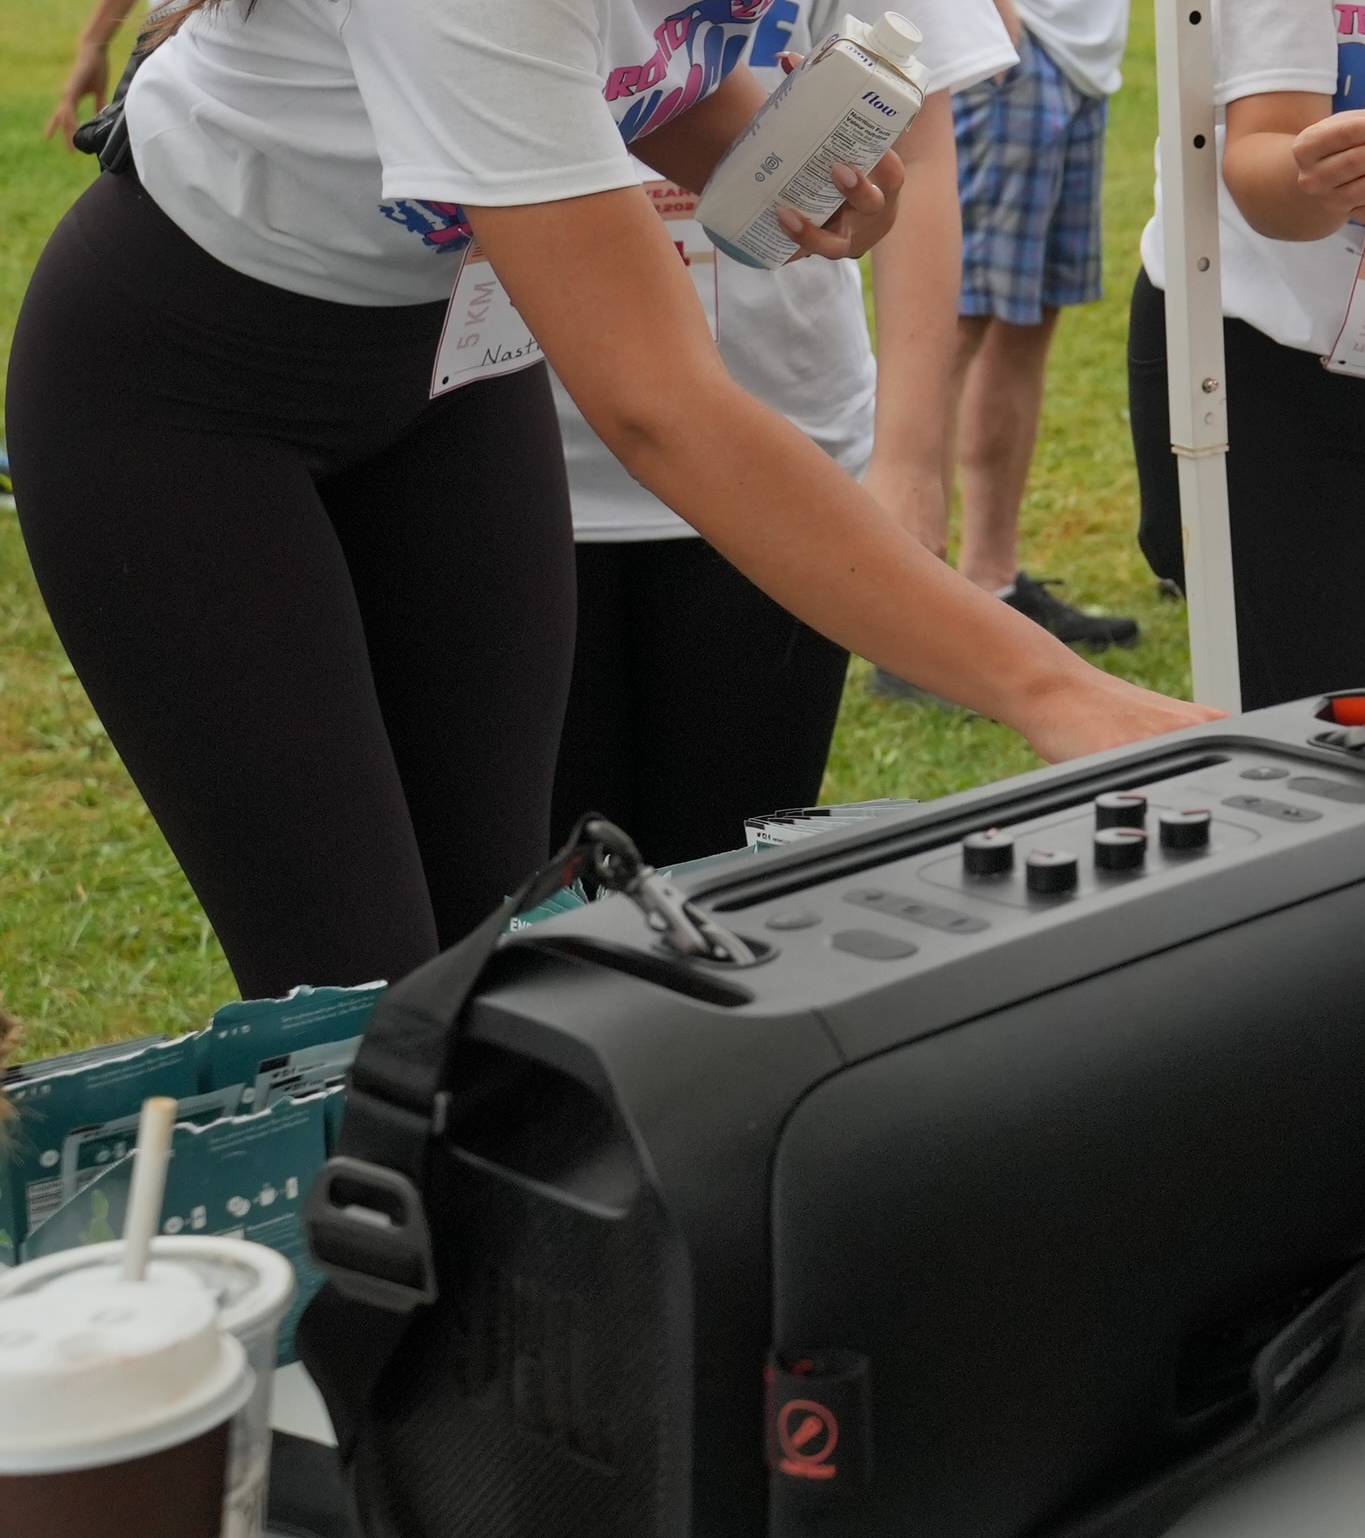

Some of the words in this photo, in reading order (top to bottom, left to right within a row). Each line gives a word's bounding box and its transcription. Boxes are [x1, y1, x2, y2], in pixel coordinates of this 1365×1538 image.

[861, 91, 897, 117] flow
[465, 280, 498, 326] KM
[456, 333, 480, 350] 5
[481, 338, 540, 367] Nast
